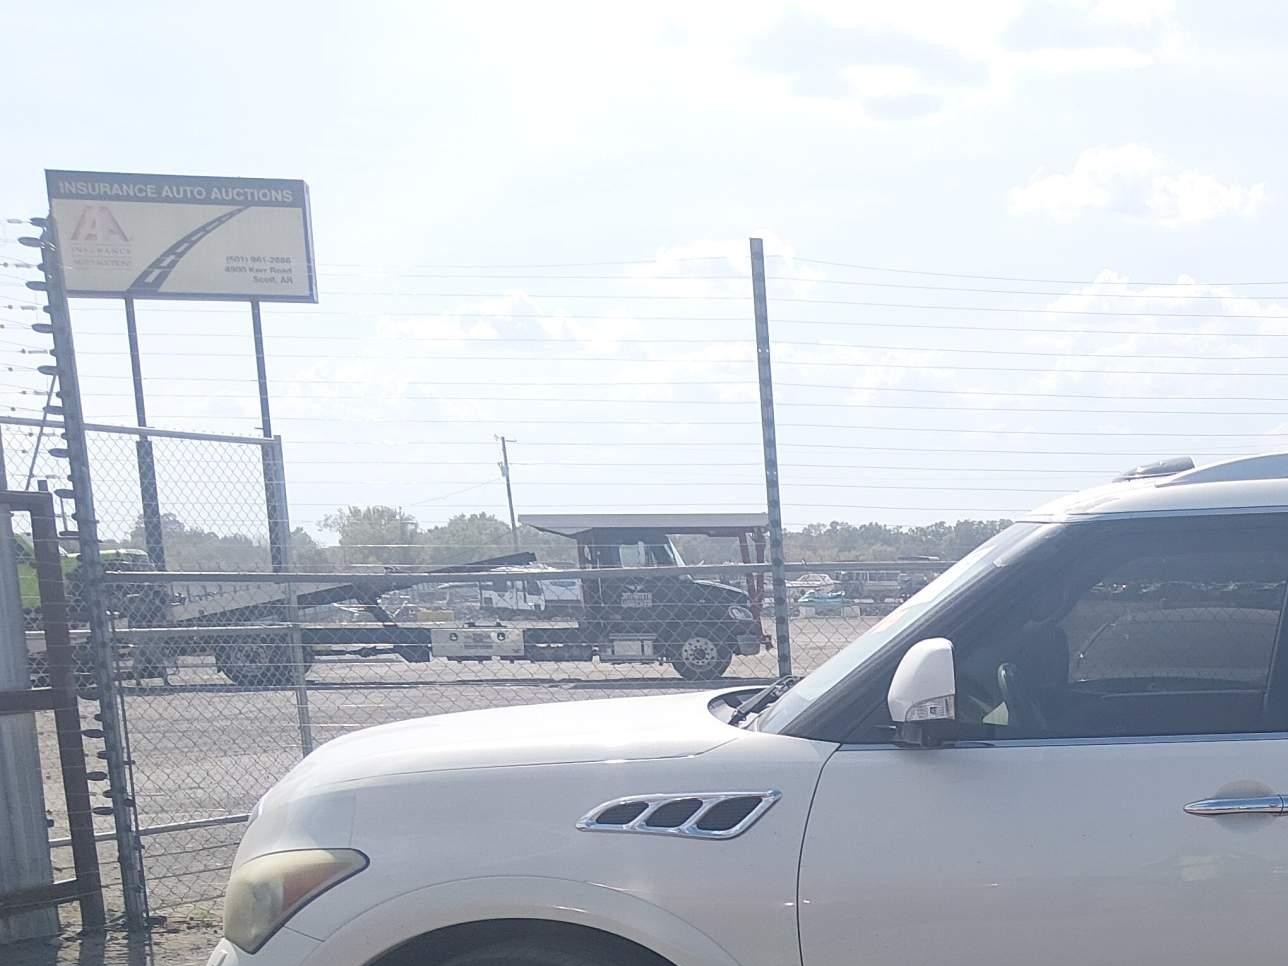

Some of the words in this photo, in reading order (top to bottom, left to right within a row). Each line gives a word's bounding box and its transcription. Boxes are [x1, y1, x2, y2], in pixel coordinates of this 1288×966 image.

[59, 181, 157, 198] INSURANCE
[161, 185, 206, 200] AUTO
[211, 187, 293, 202] AUCTIONS
